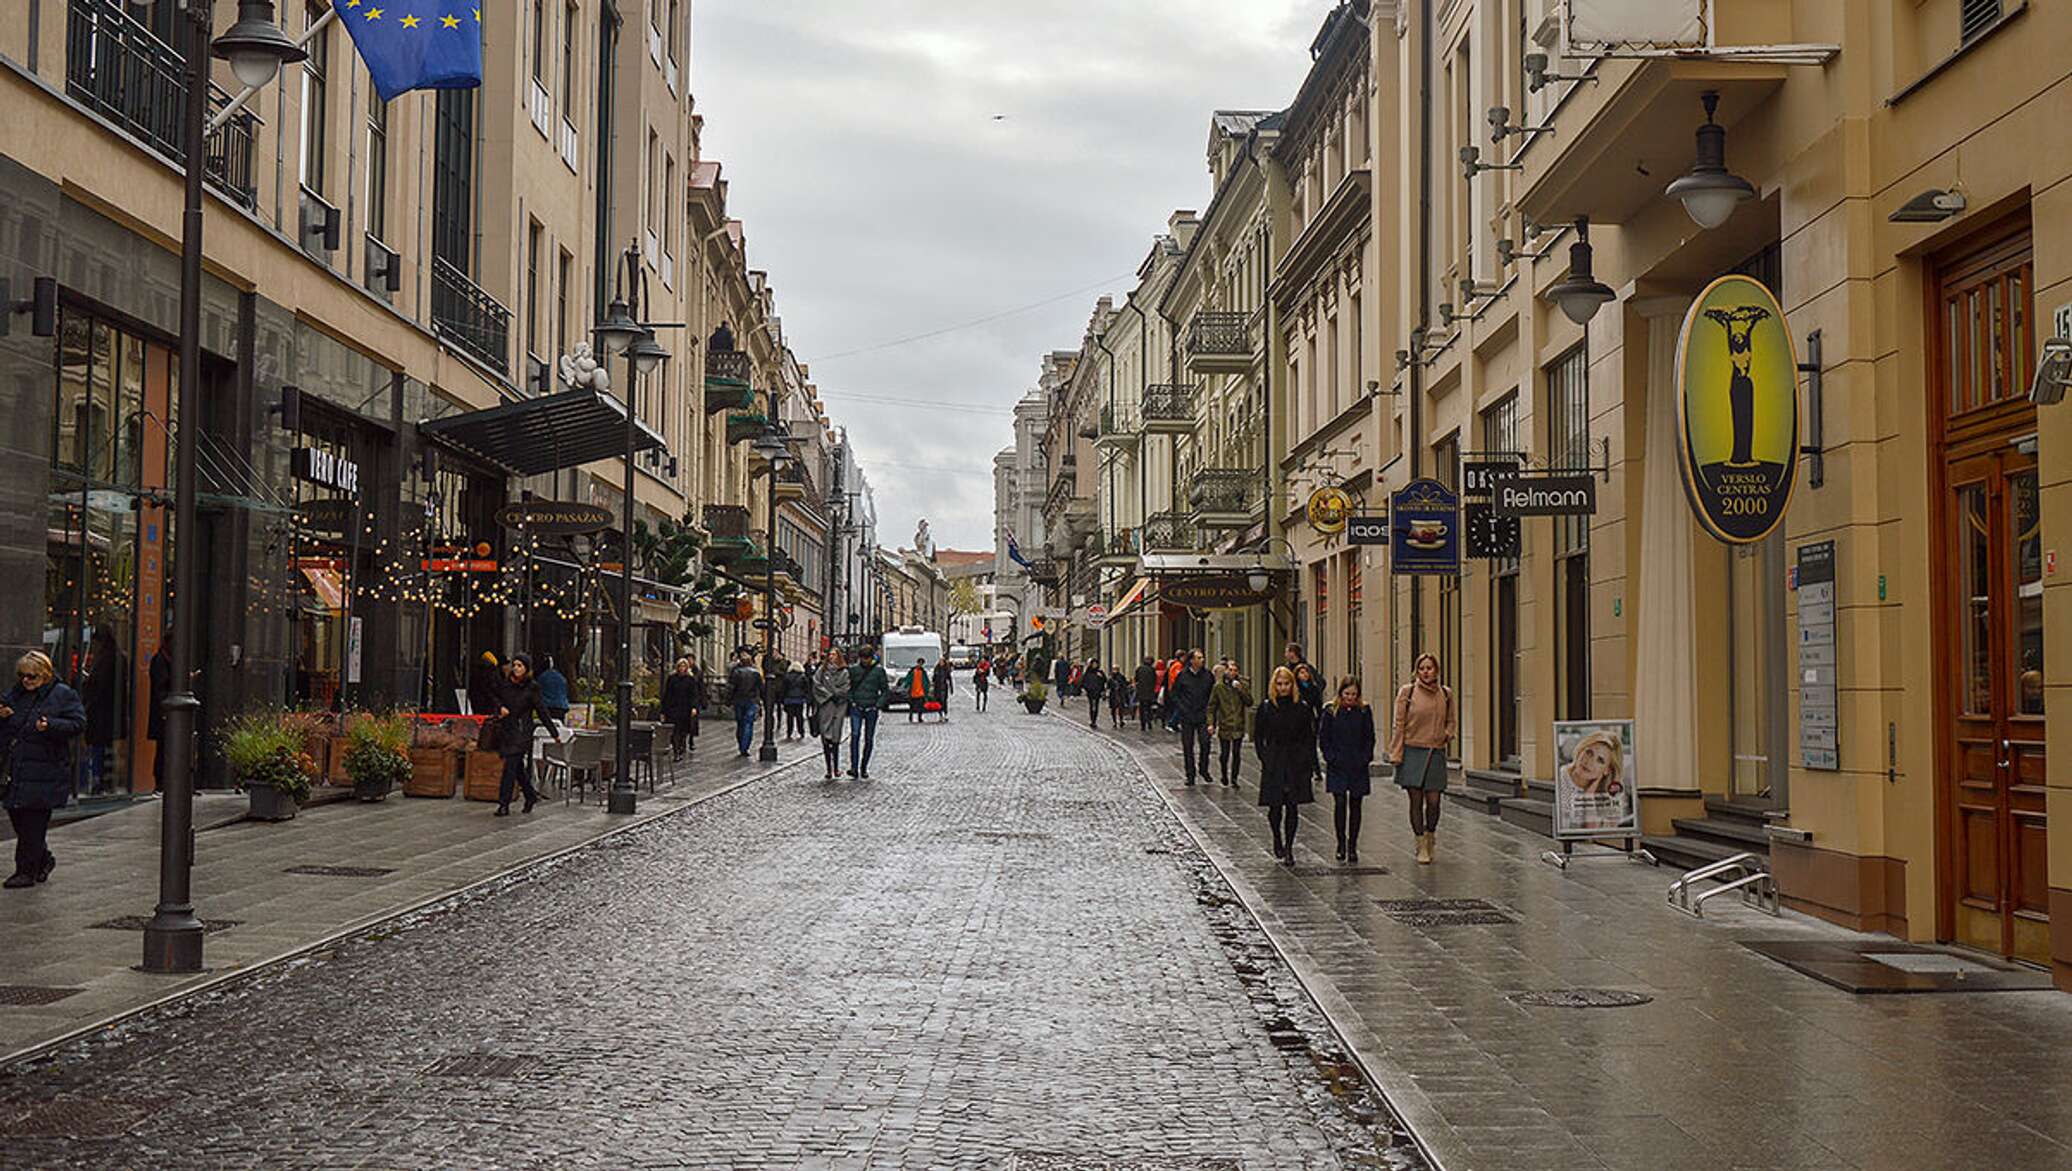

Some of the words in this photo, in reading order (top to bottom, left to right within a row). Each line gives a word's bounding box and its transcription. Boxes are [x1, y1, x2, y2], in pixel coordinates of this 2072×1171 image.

[309, 447, 334, 484] VERO
[1720, 473, 1767, 484] VERSLO
[1717, 484, 1772, 495] CENTRAS
[1722, 496, 1767, 515] 2000
[506, 512, 554, 523] CETRO
[1168, 586, 1217, 597] CENTRO
